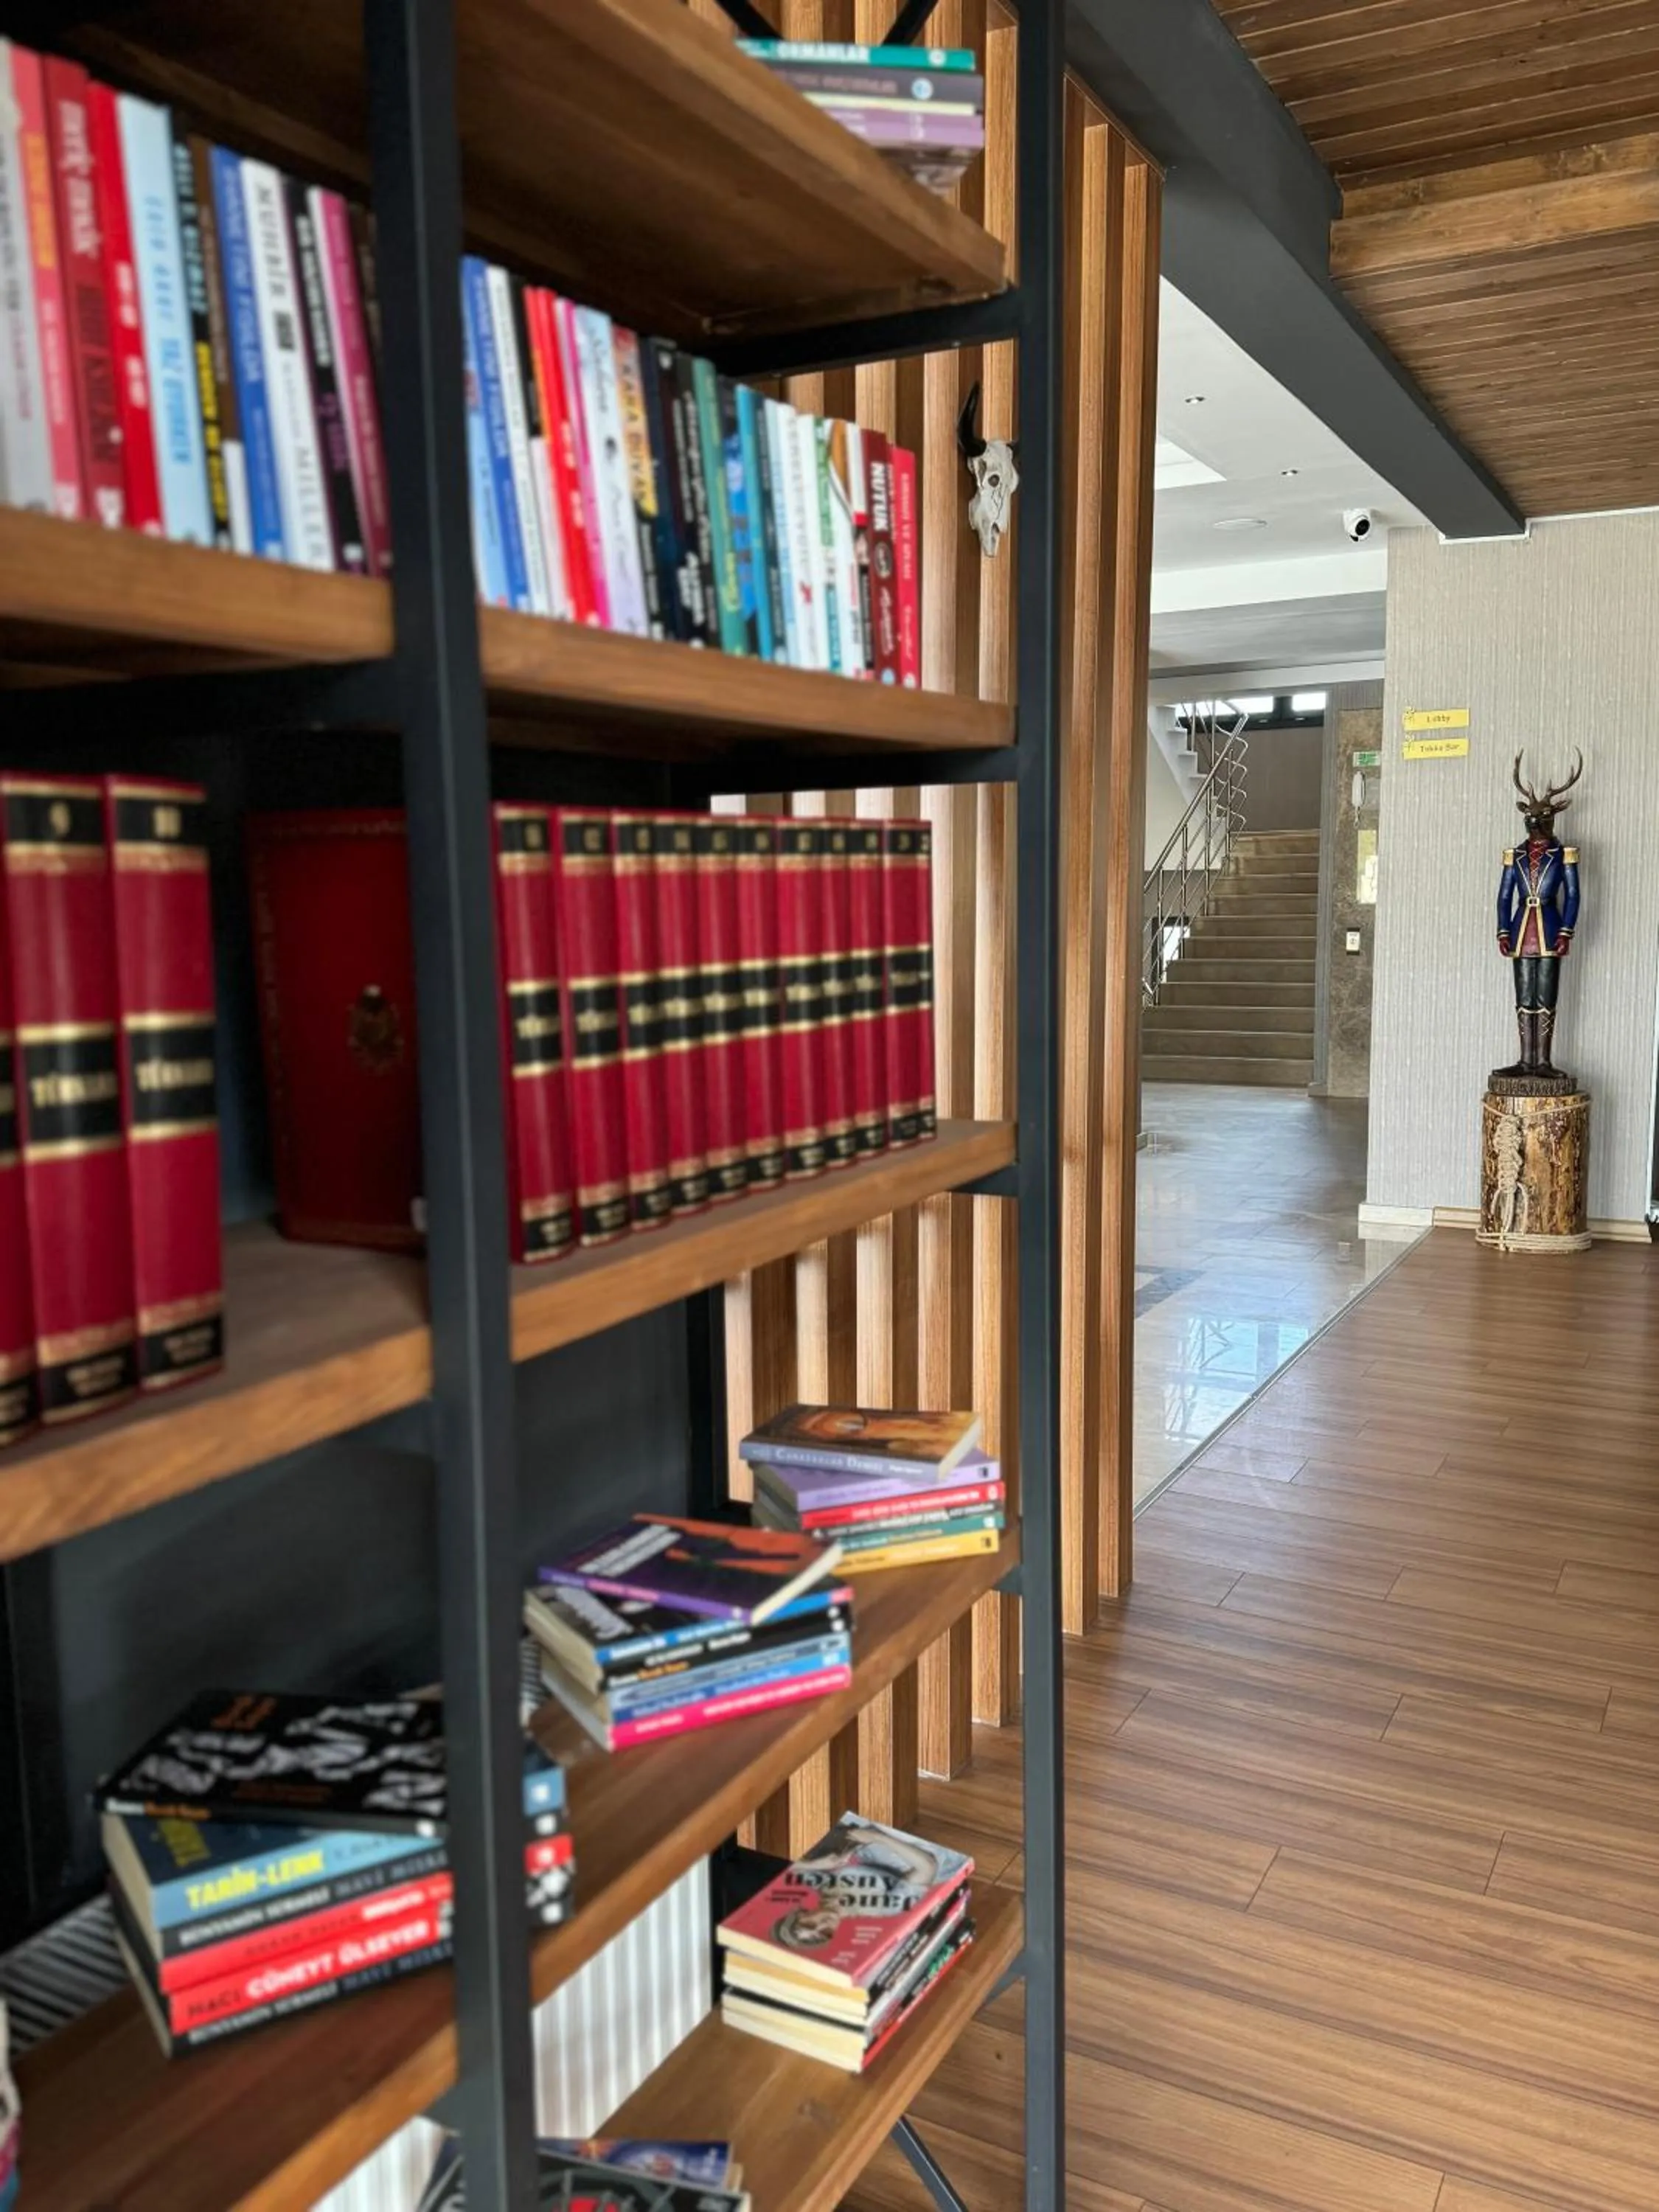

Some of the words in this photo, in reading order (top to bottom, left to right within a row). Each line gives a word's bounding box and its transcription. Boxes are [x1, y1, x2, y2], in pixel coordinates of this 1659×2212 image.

[871, 460, 888, 531] NUTUK
[1427, 714, 1450, 723] Lobby
[785, 1871, 902, 1892] Austen
[838, 1893, 920, 1911] Jane
